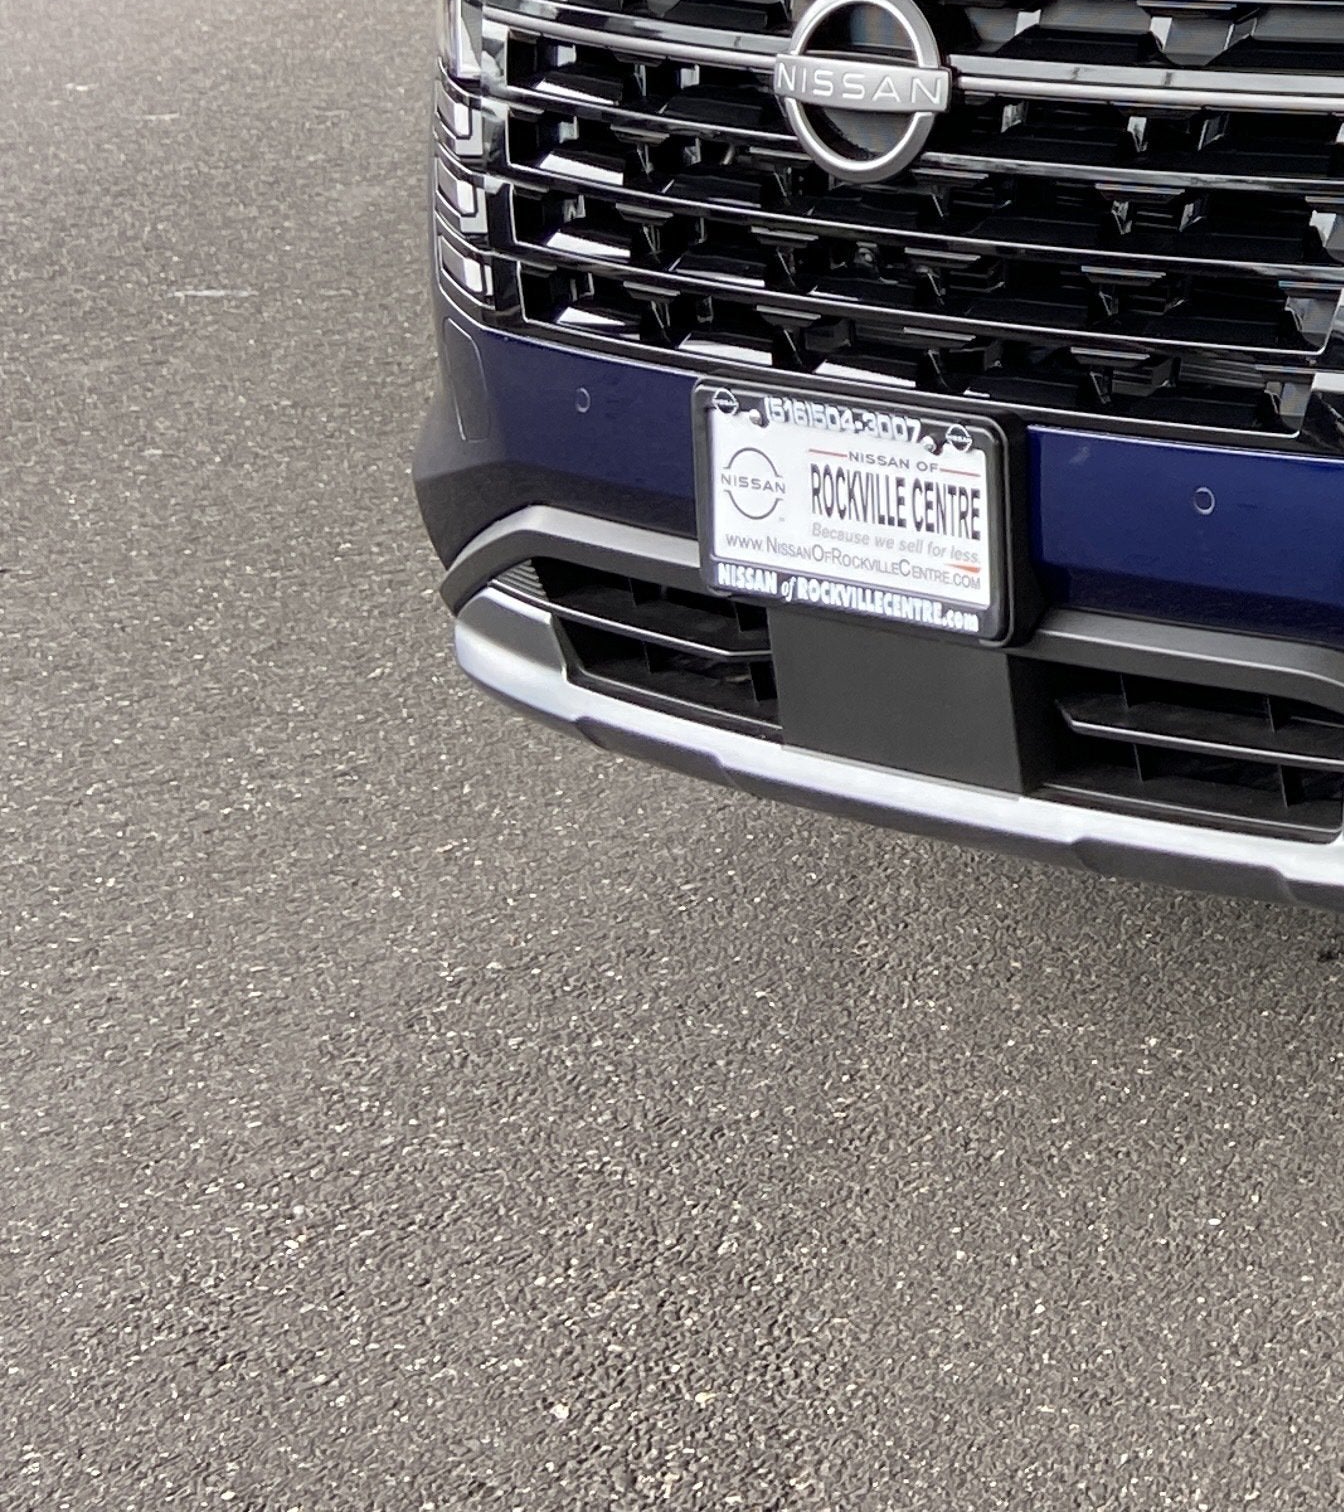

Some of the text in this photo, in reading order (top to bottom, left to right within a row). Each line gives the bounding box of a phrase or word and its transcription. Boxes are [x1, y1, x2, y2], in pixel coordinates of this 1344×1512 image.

[777, 62, 942, 105] NISSAN
[848, 451, 939, 472] NISSAN OF
[720, 473, 786, 494] NISSAN
[810, 463, 981, 541] ROCKVILLE CENTRE
[811, 522, 870, 545] Because
[875, 536, 895, 549] we
[898, 539, 924, 554] sell
[927, 541, 947, 557] for
[717, 562, 778, 595] NISSAN
[781, 576, 797, 602] of
